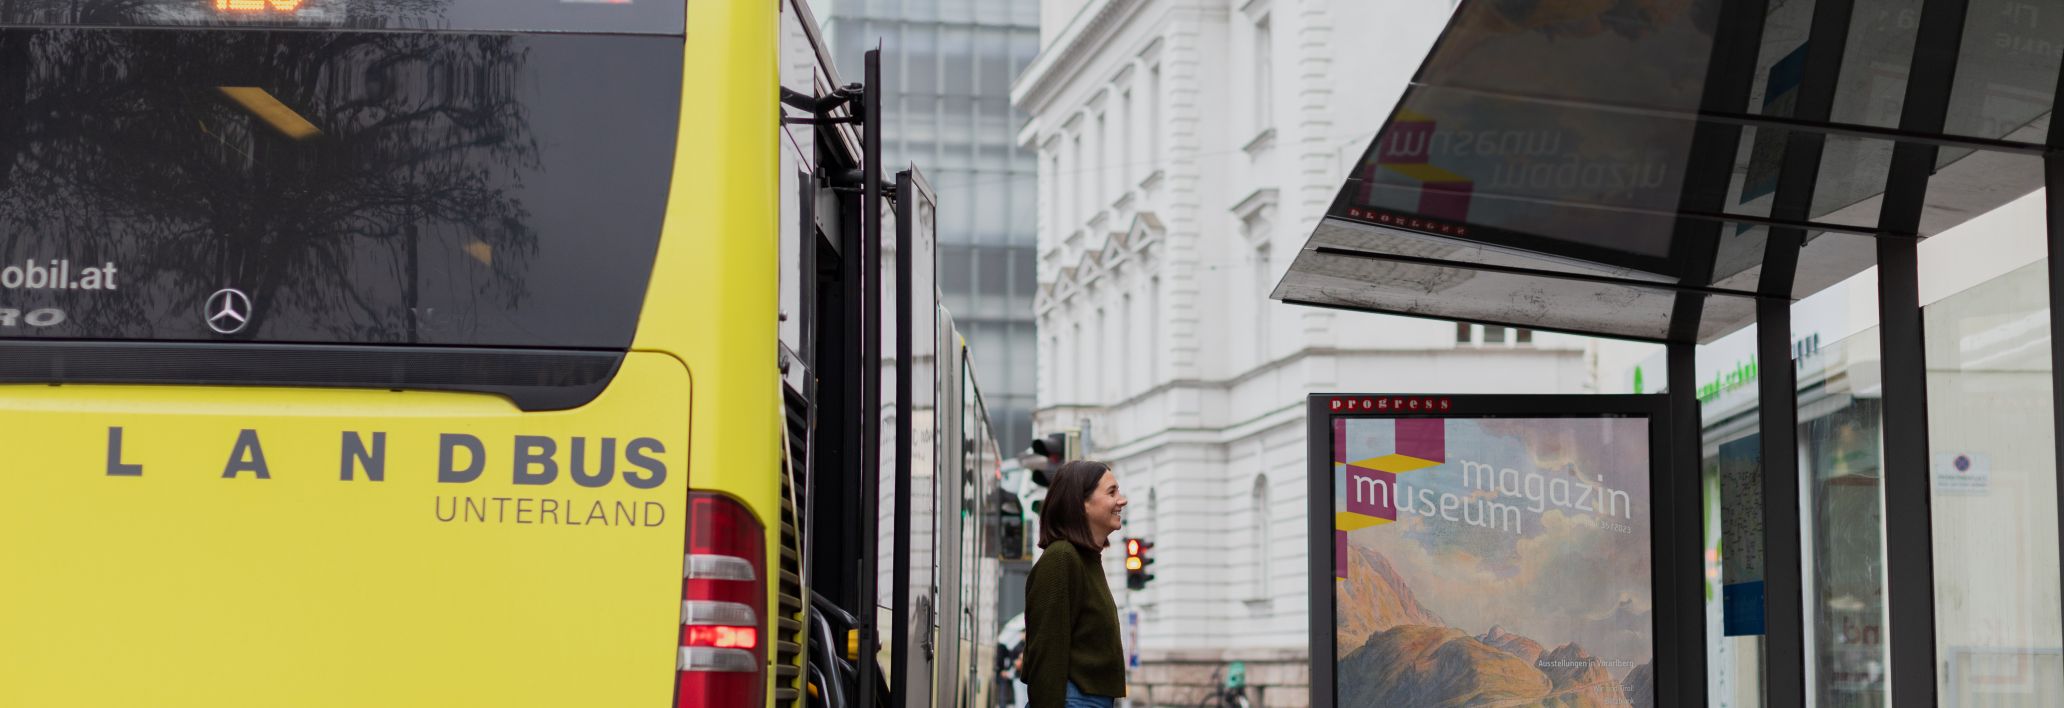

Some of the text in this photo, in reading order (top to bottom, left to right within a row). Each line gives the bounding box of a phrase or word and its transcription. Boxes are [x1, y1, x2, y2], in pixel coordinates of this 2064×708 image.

[1, 258, 118, 290] obil.at
[1332, 398, 1448, 410] progress
[1353, 474, 1522, 535] museum
[1460, 458, 1632, 520] magazin
[435, 495, 666, 528] UNTERLAND
[1538, 659, 1587, 669] Ausstellungen
